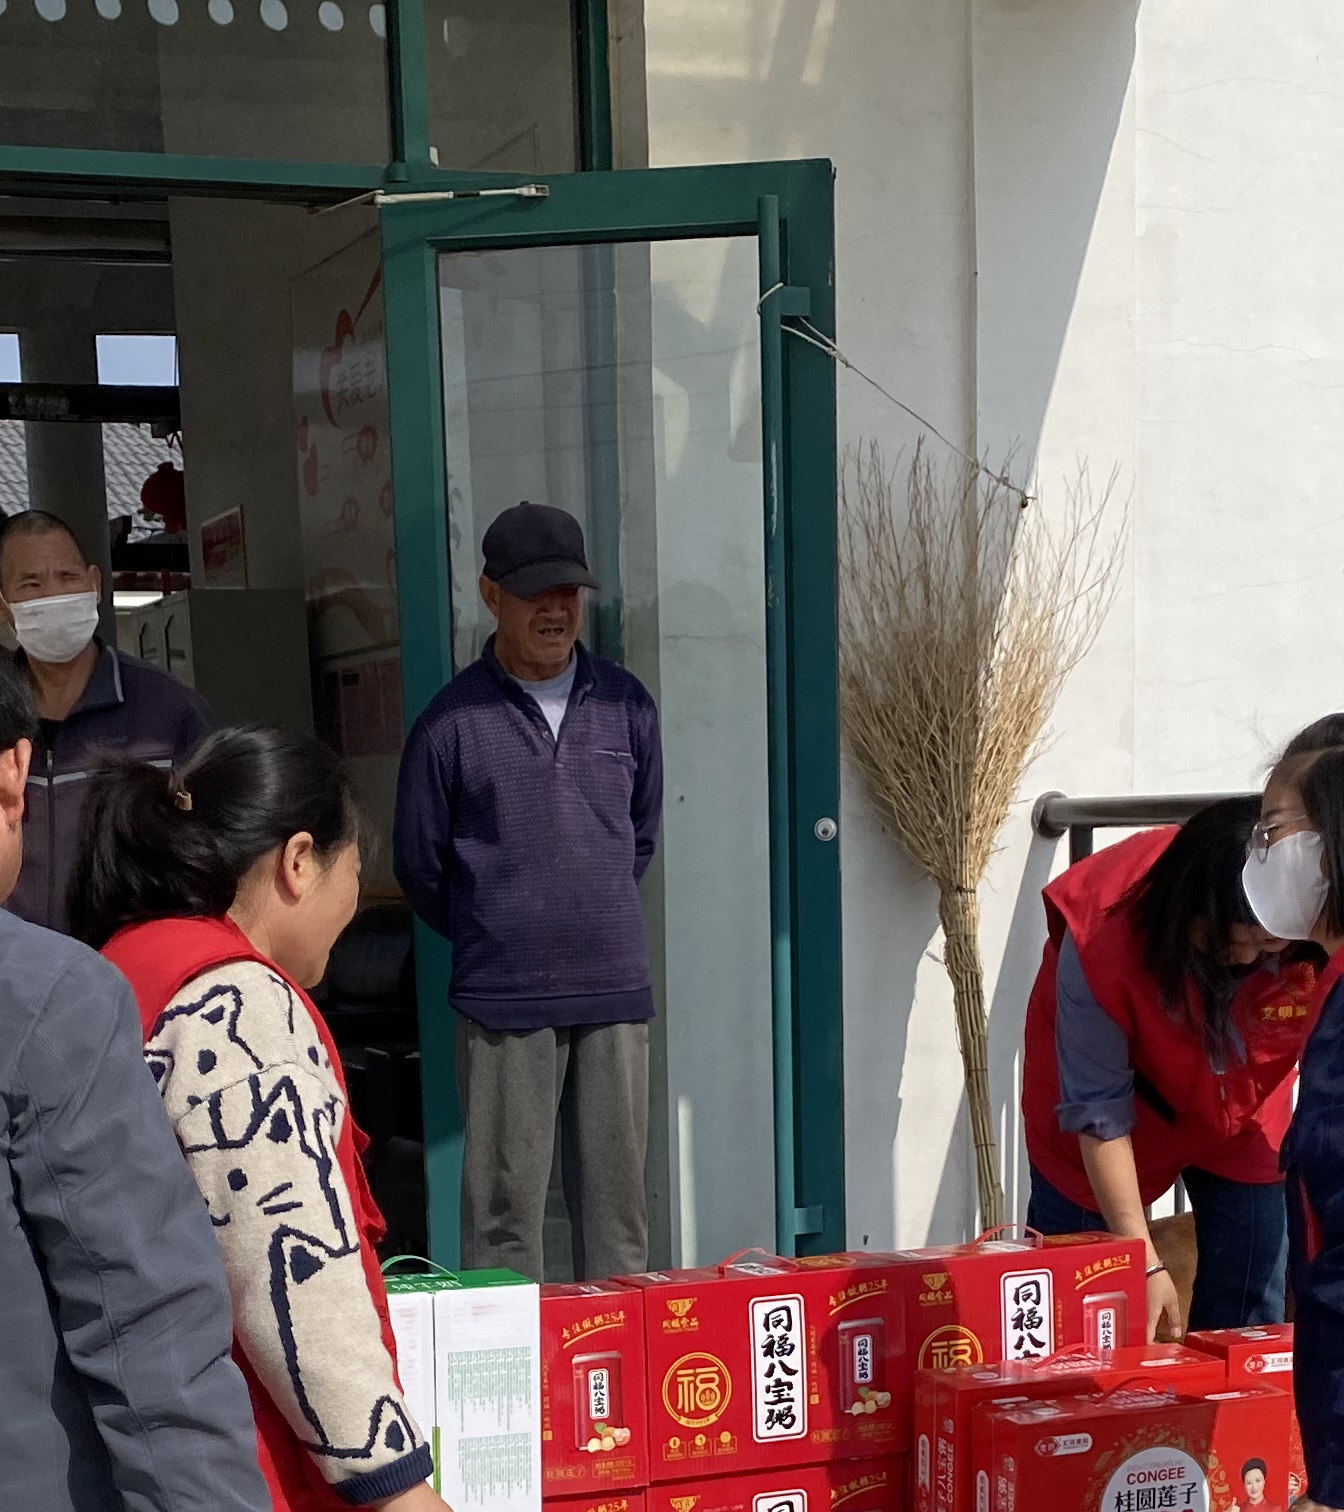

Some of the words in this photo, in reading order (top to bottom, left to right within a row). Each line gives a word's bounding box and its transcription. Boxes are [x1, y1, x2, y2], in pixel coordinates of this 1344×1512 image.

[677, 1367, 721, 1414] 福
[761, 1304, 799, 1431] 同福八宝粥
[1127, 1466, 1186, 1486] CONGEE
